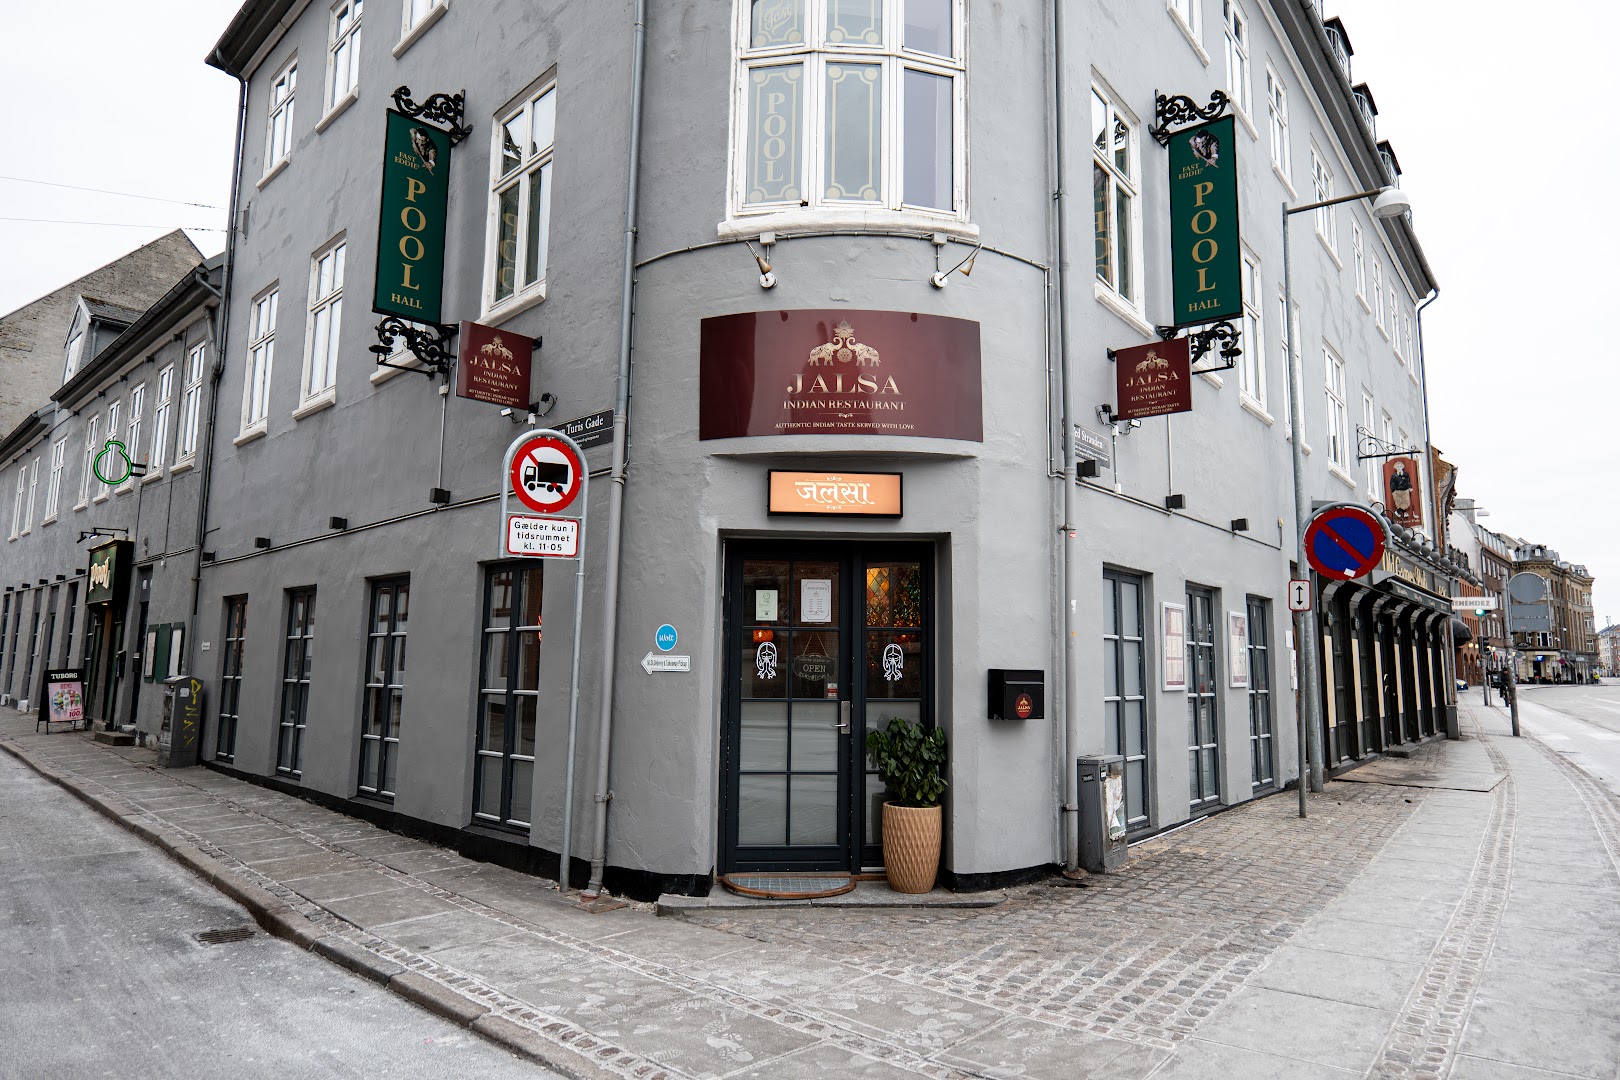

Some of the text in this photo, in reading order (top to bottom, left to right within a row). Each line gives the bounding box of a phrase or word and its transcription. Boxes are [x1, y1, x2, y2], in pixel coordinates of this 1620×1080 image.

[764, 92, 786, 183] POOL
[399, 152, 417, 162] FAST
[1182, 163, 1200, 173] FAST
[399, 176, 427, 291] POOL
[1191, 181, 1218, 293] POOL
[391, 293, 422, 309] HALL
[1188, 298, 1220, 313] HALL
[469, 355, 522, 377] JALSA
[483, 370, 508, 381] INDIAN
[1125, 370, 1180, 388] JALSA
[473, 375, 519, 391] RESTAURANT
[787, 373, 903, 396] JALSA
[1140, 384, 1165, 393] INDIAN
[1131, 389, 1177, 402] RESTAURANT
[783, 400, 907, 411] INDIAN RESTAURANT
[566, 420, 584, 435] Turis
[585, 415, 604, 430] Gade
[1081, 430, 1103, 449] Stranden
[794, 481, 876, 505] जलसा
[514, 521, 548, 531] Gælder
[551, 524, 567, 532] kun
[517, 532, 570, 542] tidsrummet
[523, 542, 563, 551] kl. 11-05
[1450, 599, 1491, 607] ENÉNDEZ
[659, 633, 675, 642] Wolt
[802, 663, 826, 673] OPEN
[51, 672, 78, 680] TUBORG
